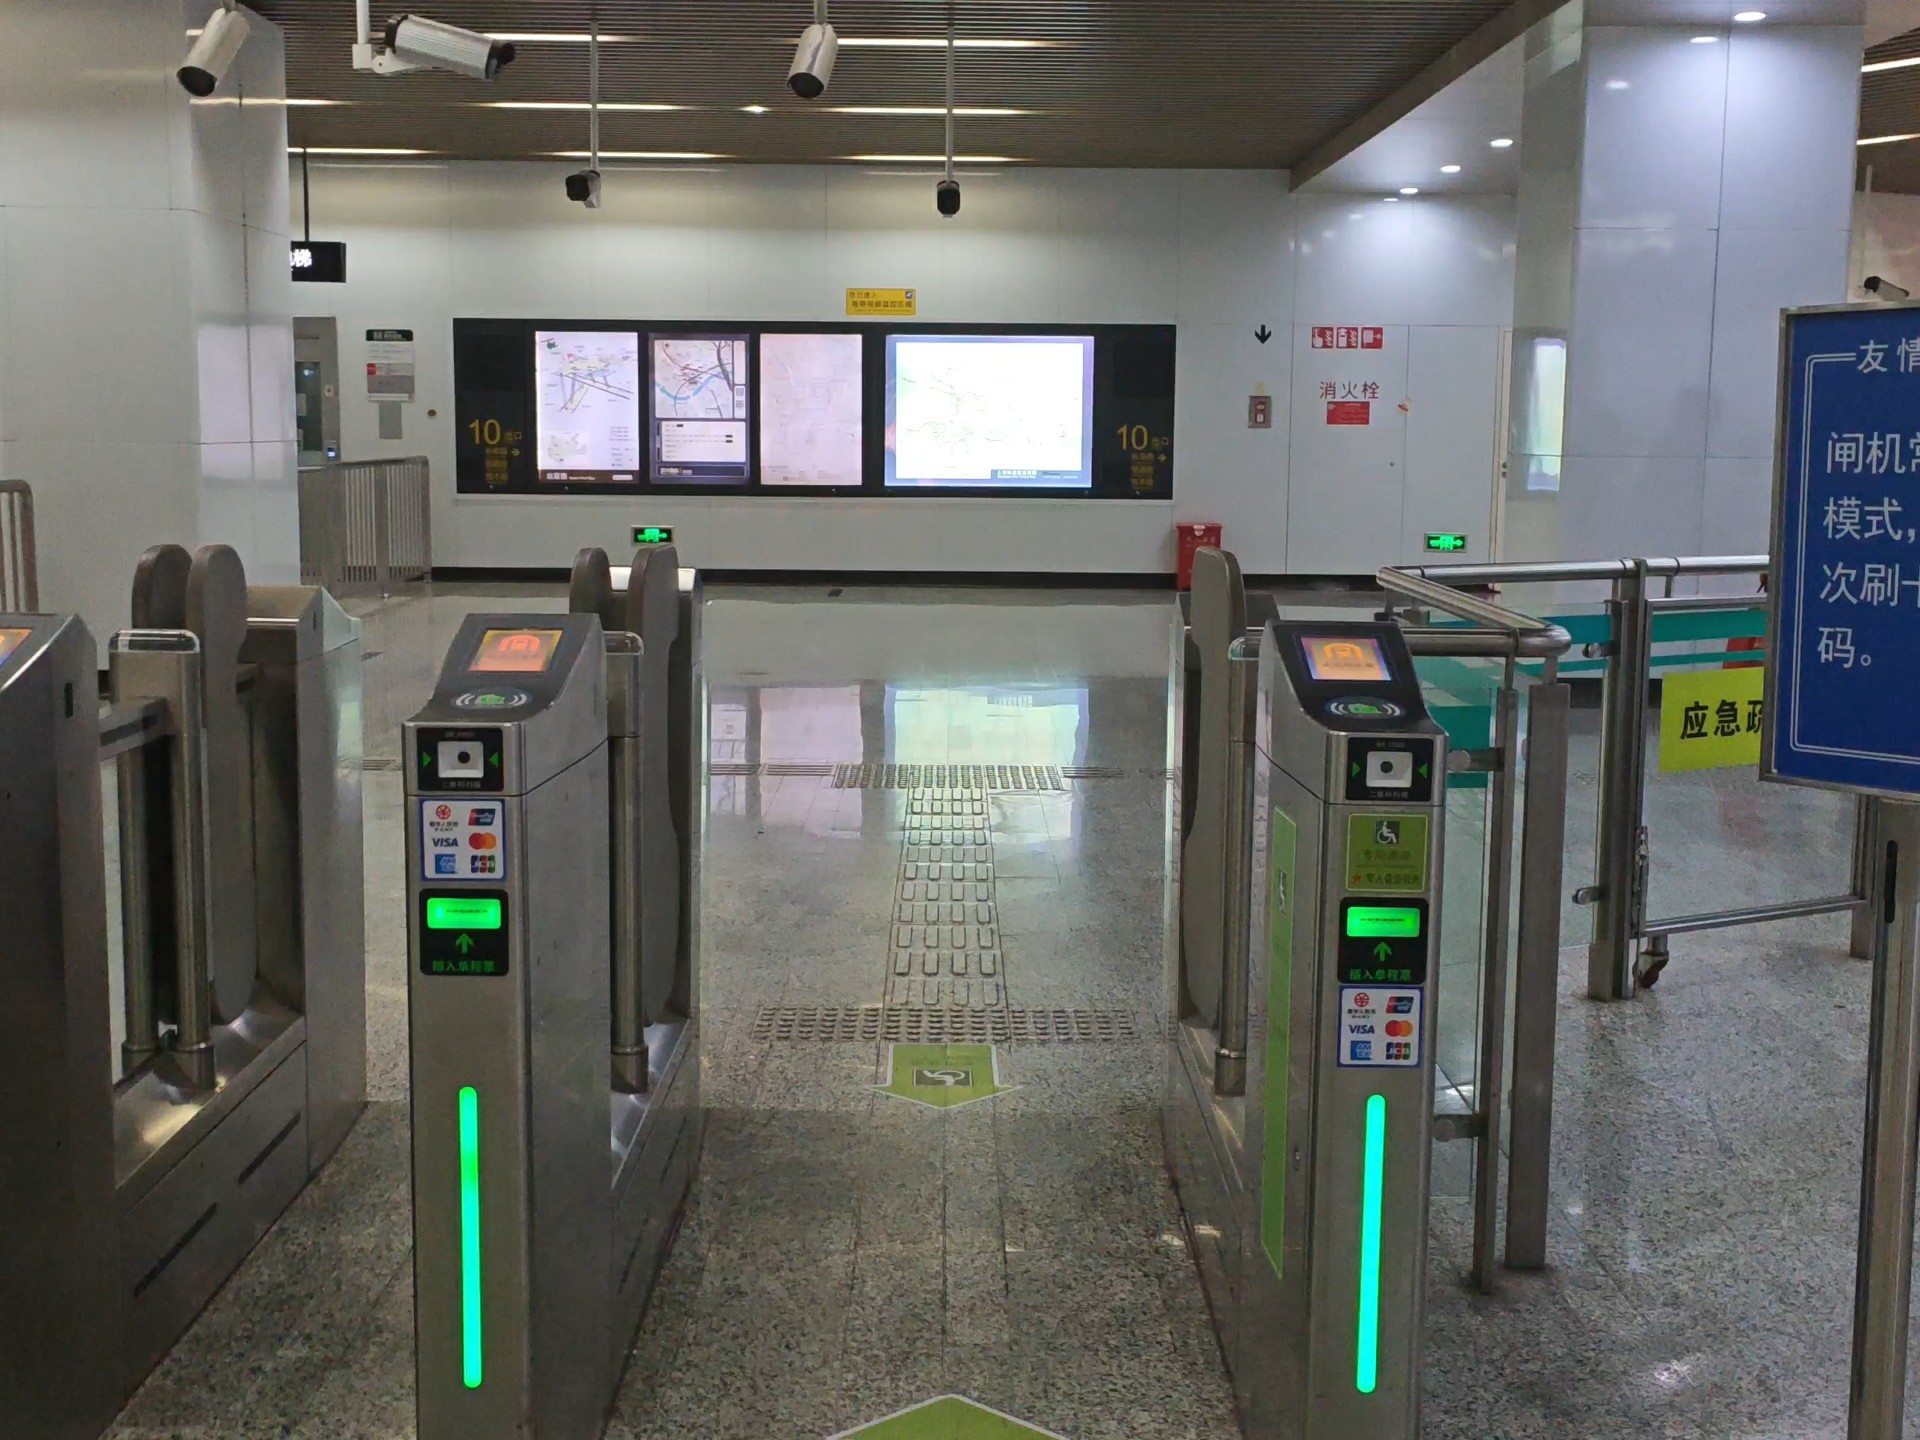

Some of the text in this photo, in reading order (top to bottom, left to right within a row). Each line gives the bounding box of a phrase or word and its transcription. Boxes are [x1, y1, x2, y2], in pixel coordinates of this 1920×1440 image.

[1857, 336, 1920, 374] 友情
[1319, 381, 1380, 400] 消火栓
[469, 418, 501, 445] 10
[1116, 424, 1148, 450] 10
[432, 837, 459, 848] VISA
[1348, 1024, 1375, 1035] VISA
